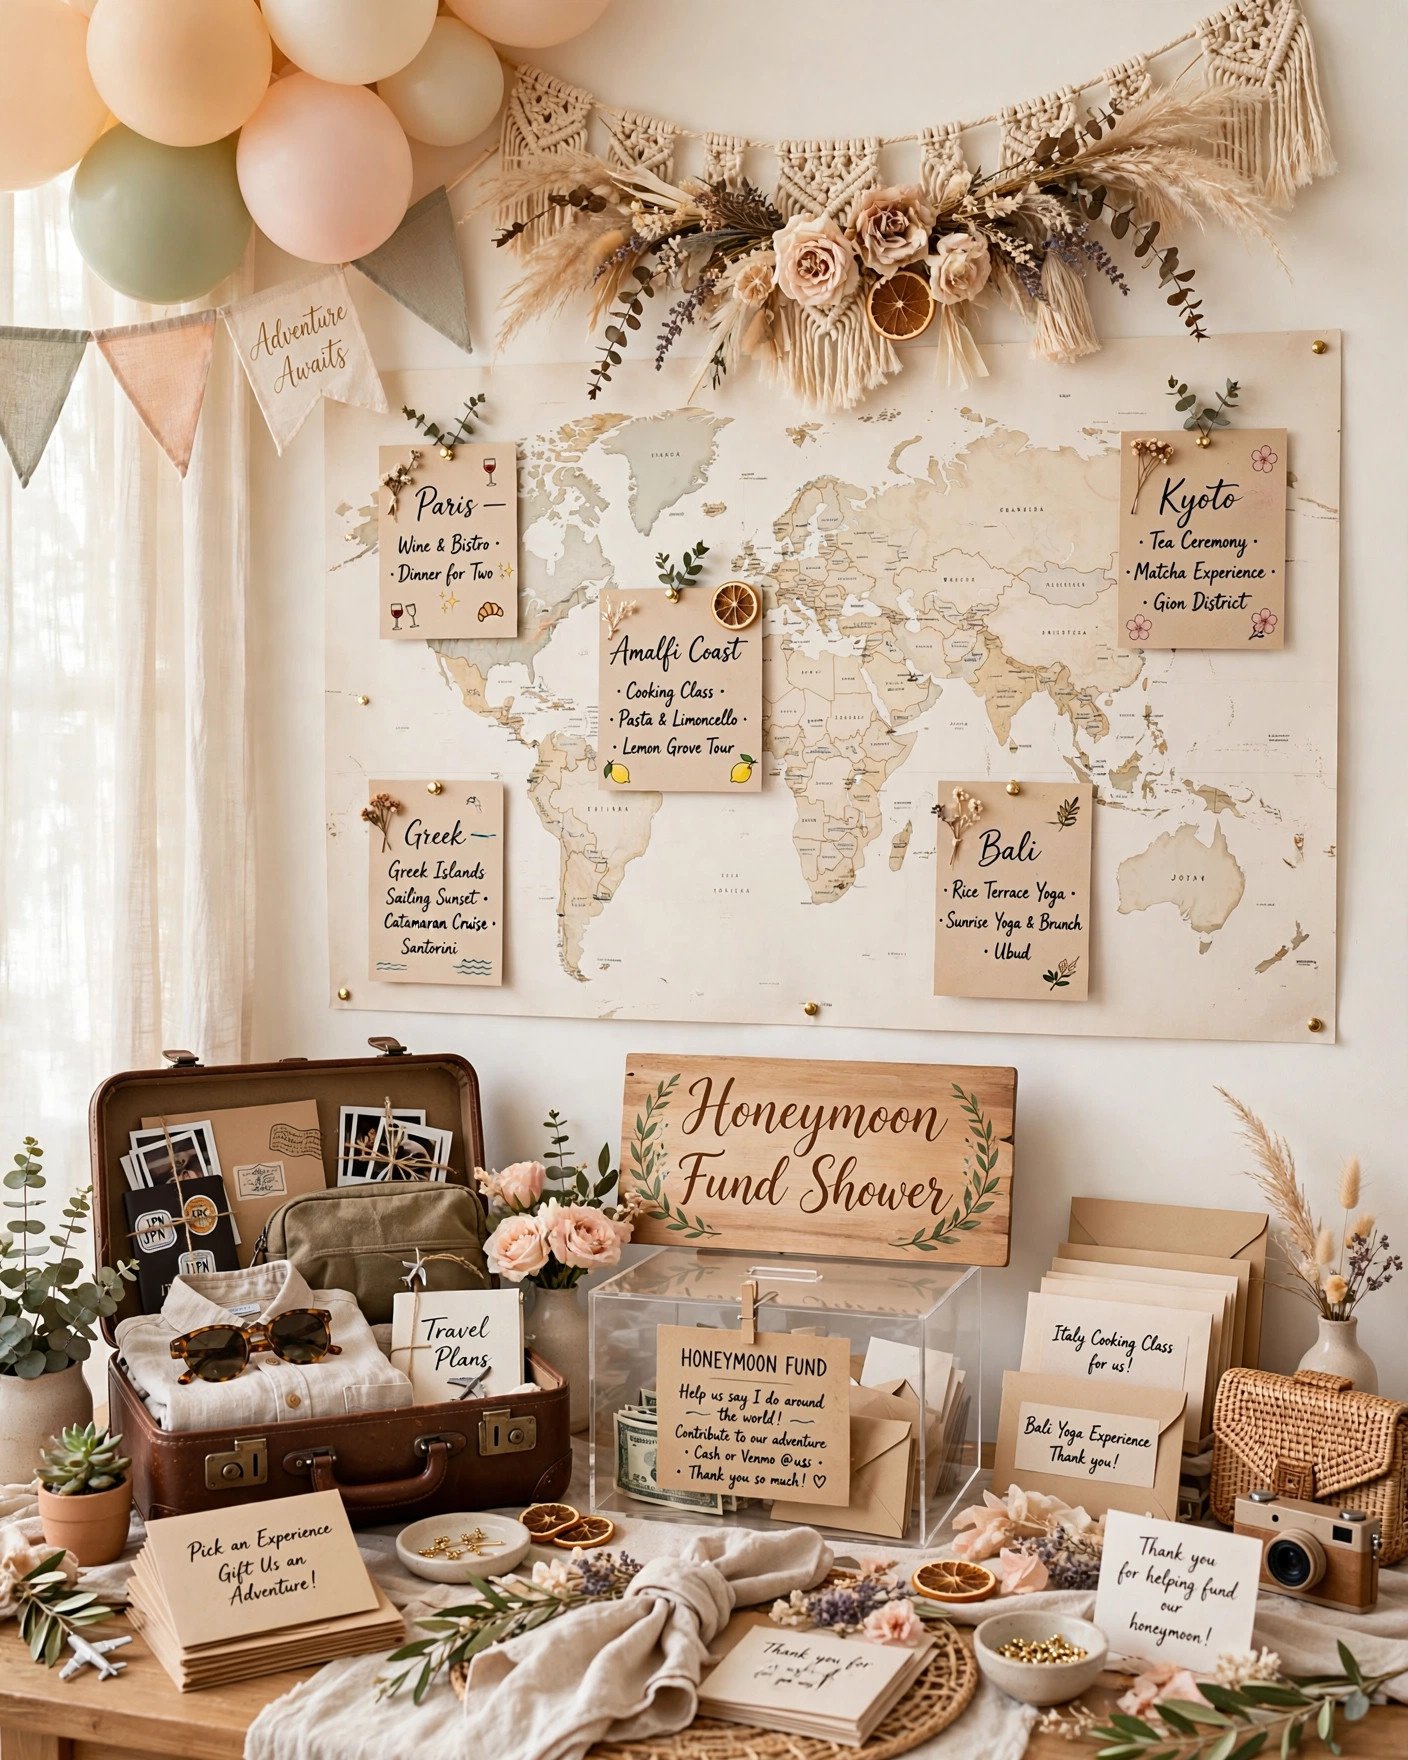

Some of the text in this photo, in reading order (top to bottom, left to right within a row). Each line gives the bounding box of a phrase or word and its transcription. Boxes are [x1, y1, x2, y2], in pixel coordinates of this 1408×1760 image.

[249, 305, 349, 362] Adventure
[273, 338, 350, 394] Awaits
[414, 485, 478, 522] Paris
[1158, 476, 1245, 529] Kyoto
[398, 533, 490, 555] Wine & Bistro
[1149, 529, 1248, 558] Tea Ceremony
[397, 561, 494, 587] Dinner for Two
[1133, 561, 1267, 586] Matcha Experience
[1153, 591, 1253, 613] Gion District
[609, 634, 749, 673] Amalfi Coast
[626, 680, 714, 708] Cooking Class
[618, 708, 738, 728] Pasta & Limoncello
[622, 736, 735, 757] Lemon Grove Tour
[404, 818, 467, 850] Greek
[977, 828, 1043, 868] Bali
[388, 859, 486, 881] Greek Islands
[385, 887, 480, 912] Sailing Sunset
[952, 879, 1066, 909] Rice Terrace Yoga
[384, 912, 489, 931] Catamaran Cruise
[945, 910, 1083, 937] Sunrise Yoga & Brunch
[401, 937, 459, 955] Santorini
[994, 942, 1032, 961] Ubud
[681, 1076, 948, 1158] Honeymoon
[677, 1149, 954, 1215] Fund Shower
[421, 1315, 491, 1341] Travel
[1051, 1324, 1174, 1358] Italy Cooking Class
[434, 1345, 492, 1371] Plans
[680, 1347, 828, 1377] HONEYMOON FUND
[1088, 1353, 1133, 1375] for us!
[679, 1383, 826, 1410] Help us say I do around
[716, 1408, 783, 1426] the world!
[675, 1424, 730, 1443] Contribute
[735, 1428, 746, 1443] to
[750, 1433, 768, 1444] our
[772, 1430, 828, 1449] adventure
[1023, 1415, 1152, 1449] Bali Yoga Experience
[693, 1445, 720, 1461] Cash
[725, 1452, 737, 1461] or
[740, 1449, 776, 1465] Venmo
[1049, 1445, 1120, 1475] Thank you!
[688, 1464, 806, 1490] Thank you so much!
[186, 1523, 333, 1562] Pick an Experience
[1138, 1535, 1219, 1574] Thank you
[218, 1555, 307, 1585] Gift Us an
[1117, 1561, 1240, 1602] for helping fund
[228, 1569, 317, 1607] Adventure!
[1160, 1602, 1184, 1615] our
[1128, 1611, 1213, 1647] honeymoon!
[763, 1641, 811, 1660] Thank
[815, 1656, 841, 1665] you
